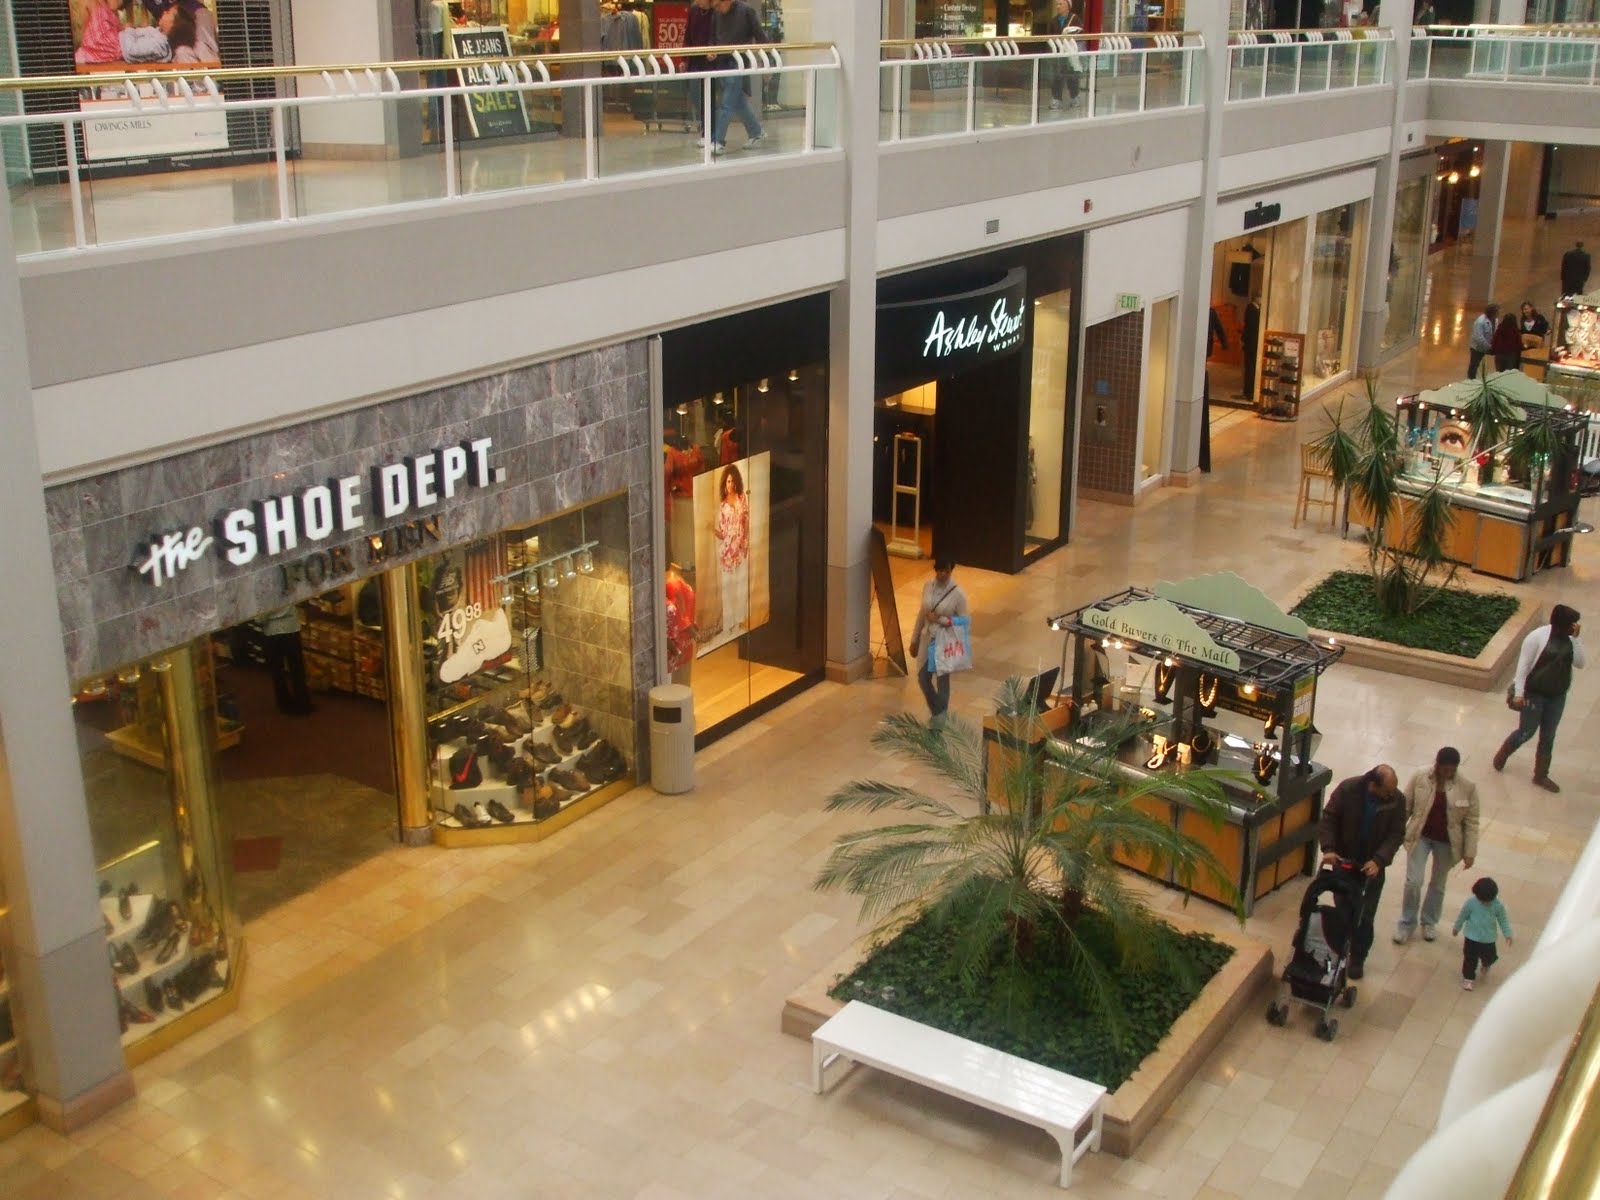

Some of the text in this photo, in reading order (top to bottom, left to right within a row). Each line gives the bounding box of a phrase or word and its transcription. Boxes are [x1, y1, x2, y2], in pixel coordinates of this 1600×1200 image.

[462, 38, 502, 55] AE JEANS
[473, 90, 517, 113] SALE
[94, 120, 152, 132] OWINGS MILLS
[1121, 295, 1137, 308] EXIT
[923, 311, 988, 357] Ashley
[139, 437, 506, 587] the SHOE DEPT.
[1091, 614, 1117, 630] Gold
[1161, 634, 1171, 646] @
[1176, 638, 1197, 654] The
[1202, 647, 1231, 665] Mall
